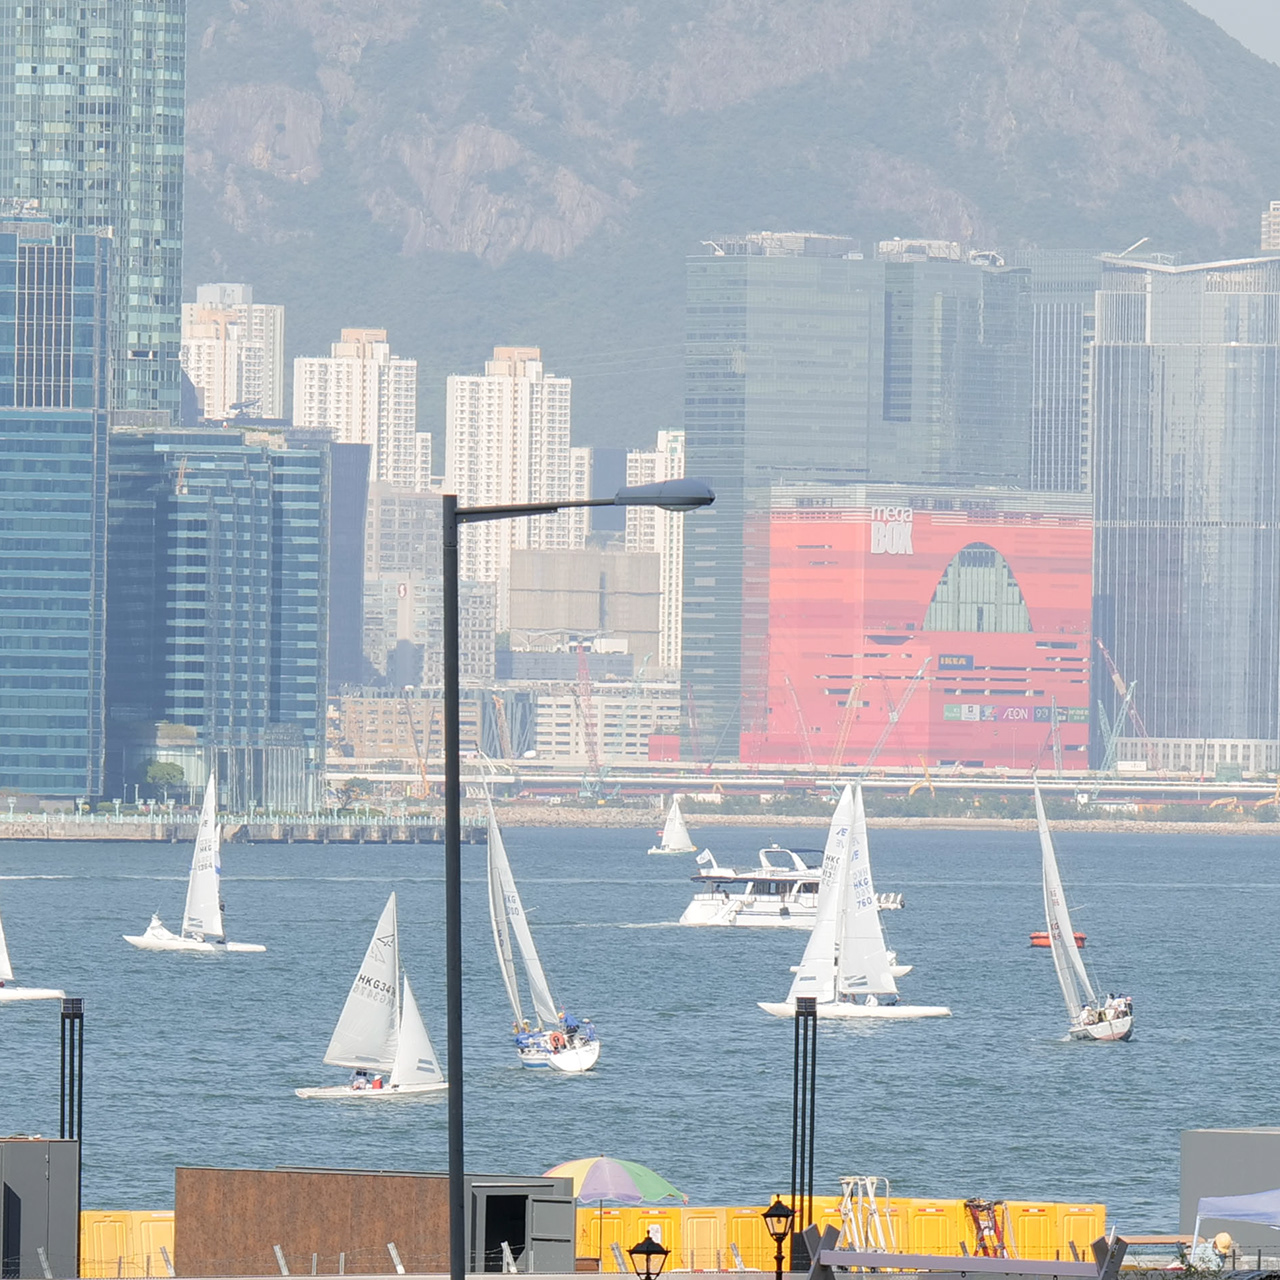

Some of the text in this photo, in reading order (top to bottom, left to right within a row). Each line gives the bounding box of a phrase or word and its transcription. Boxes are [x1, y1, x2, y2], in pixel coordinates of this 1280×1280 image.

[871, 506, 913, 524] mega
[871, 522, 914, 554] BOX
[940, 657, 966, 665] IKEA
[856, 897, 873, 909] 760
